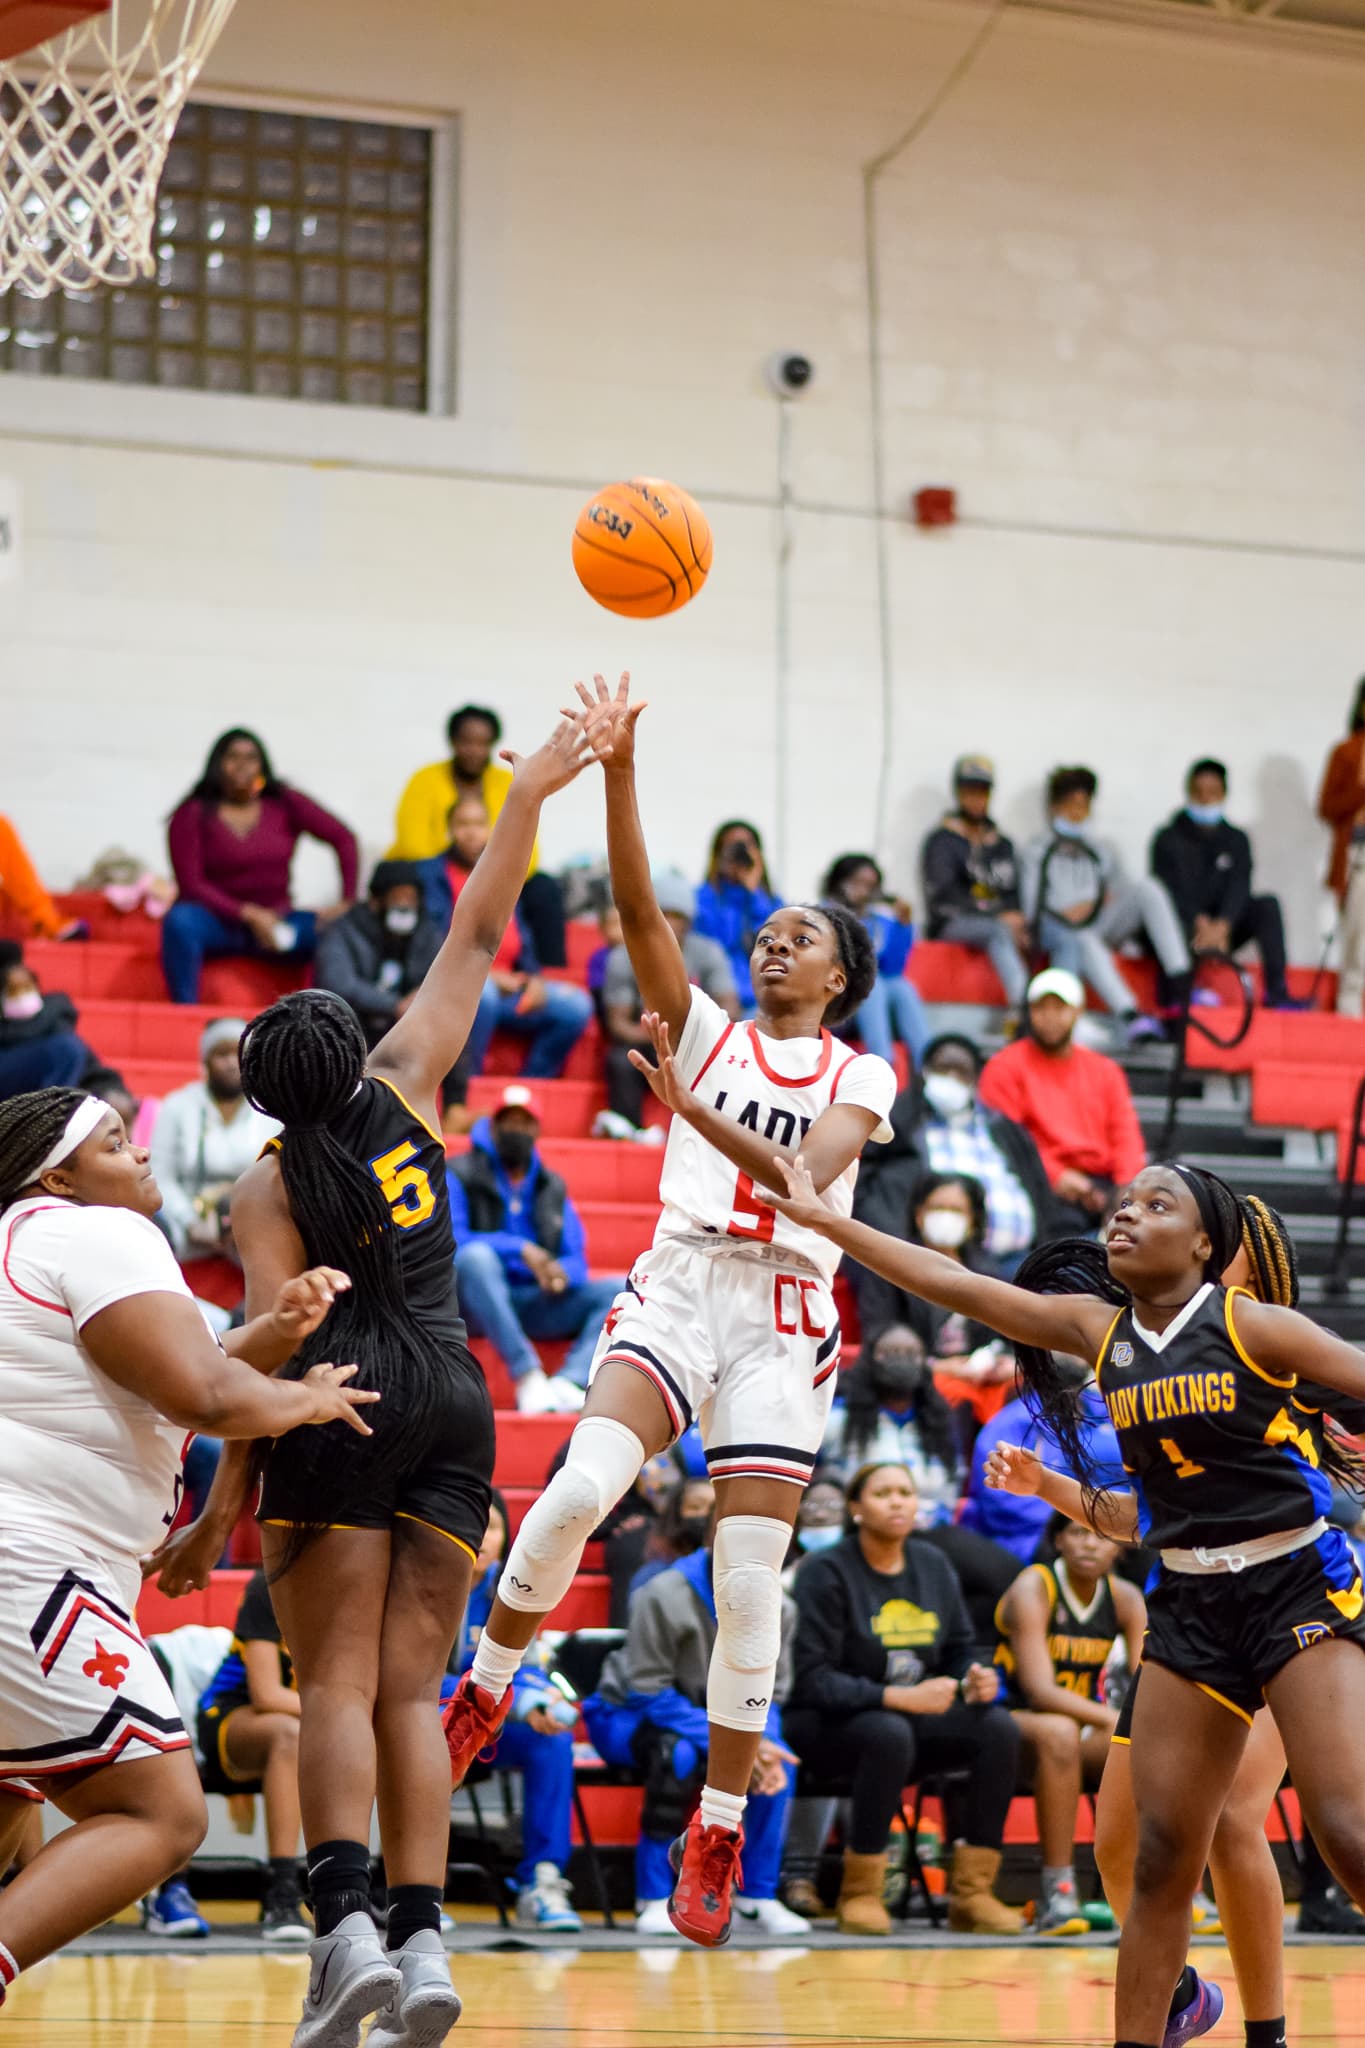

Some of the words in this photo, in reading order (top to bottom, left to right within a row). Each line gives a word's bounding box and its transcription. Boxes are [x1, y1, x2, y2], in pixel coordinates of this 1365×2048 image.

[773, 1273, 827, 1339] CC
[1141, 1371, 1237, 1423] VIKINGS
[1159, 1438, 1207, 1480] 1
